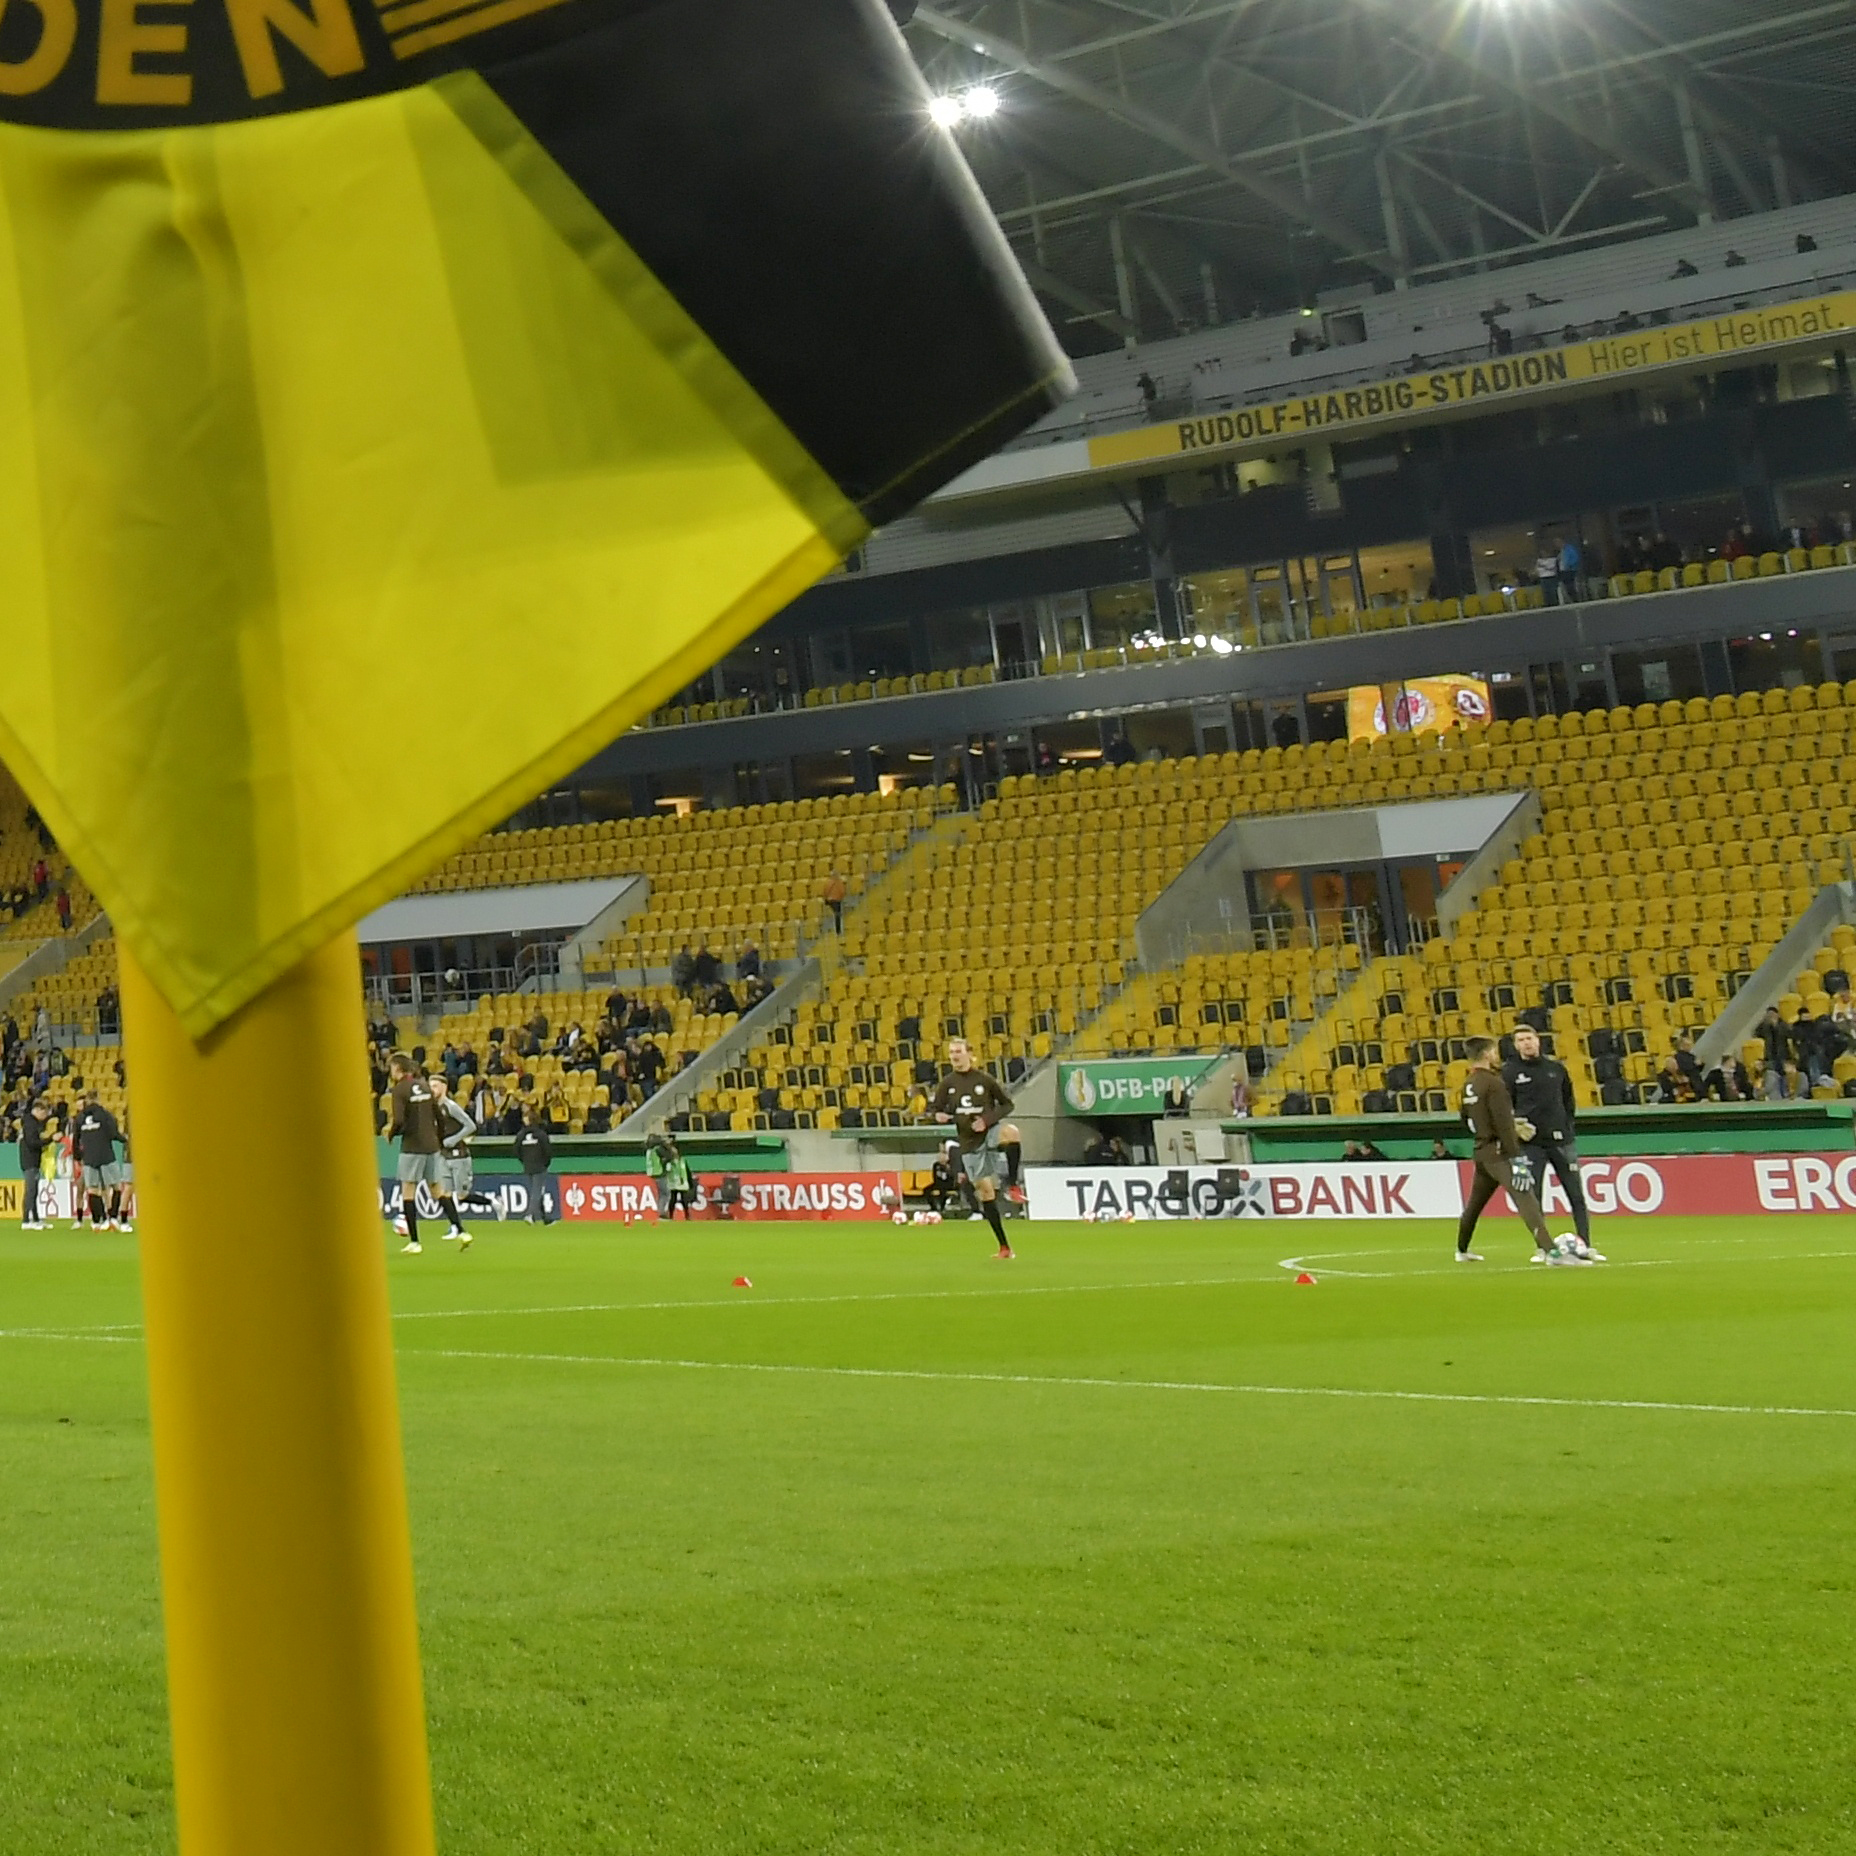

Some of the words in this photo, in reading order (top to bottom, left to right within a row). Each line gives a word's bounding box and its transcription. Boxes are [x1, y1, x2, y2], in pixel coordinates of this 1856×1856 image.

[1178, 351, 1569, 450] RUDOLF-HARBIG-STADION
[1590, 343, 1651, 374] Hier
[1665, 330, 1700, 361] ist
[1715, 303, 1845, 351] Heimat.
[591, 1185, 707, 1211] STRAS
[741, 1183, 865, 1211] STRAUSS
[1505, 1162, 1664, 1214] RGO
